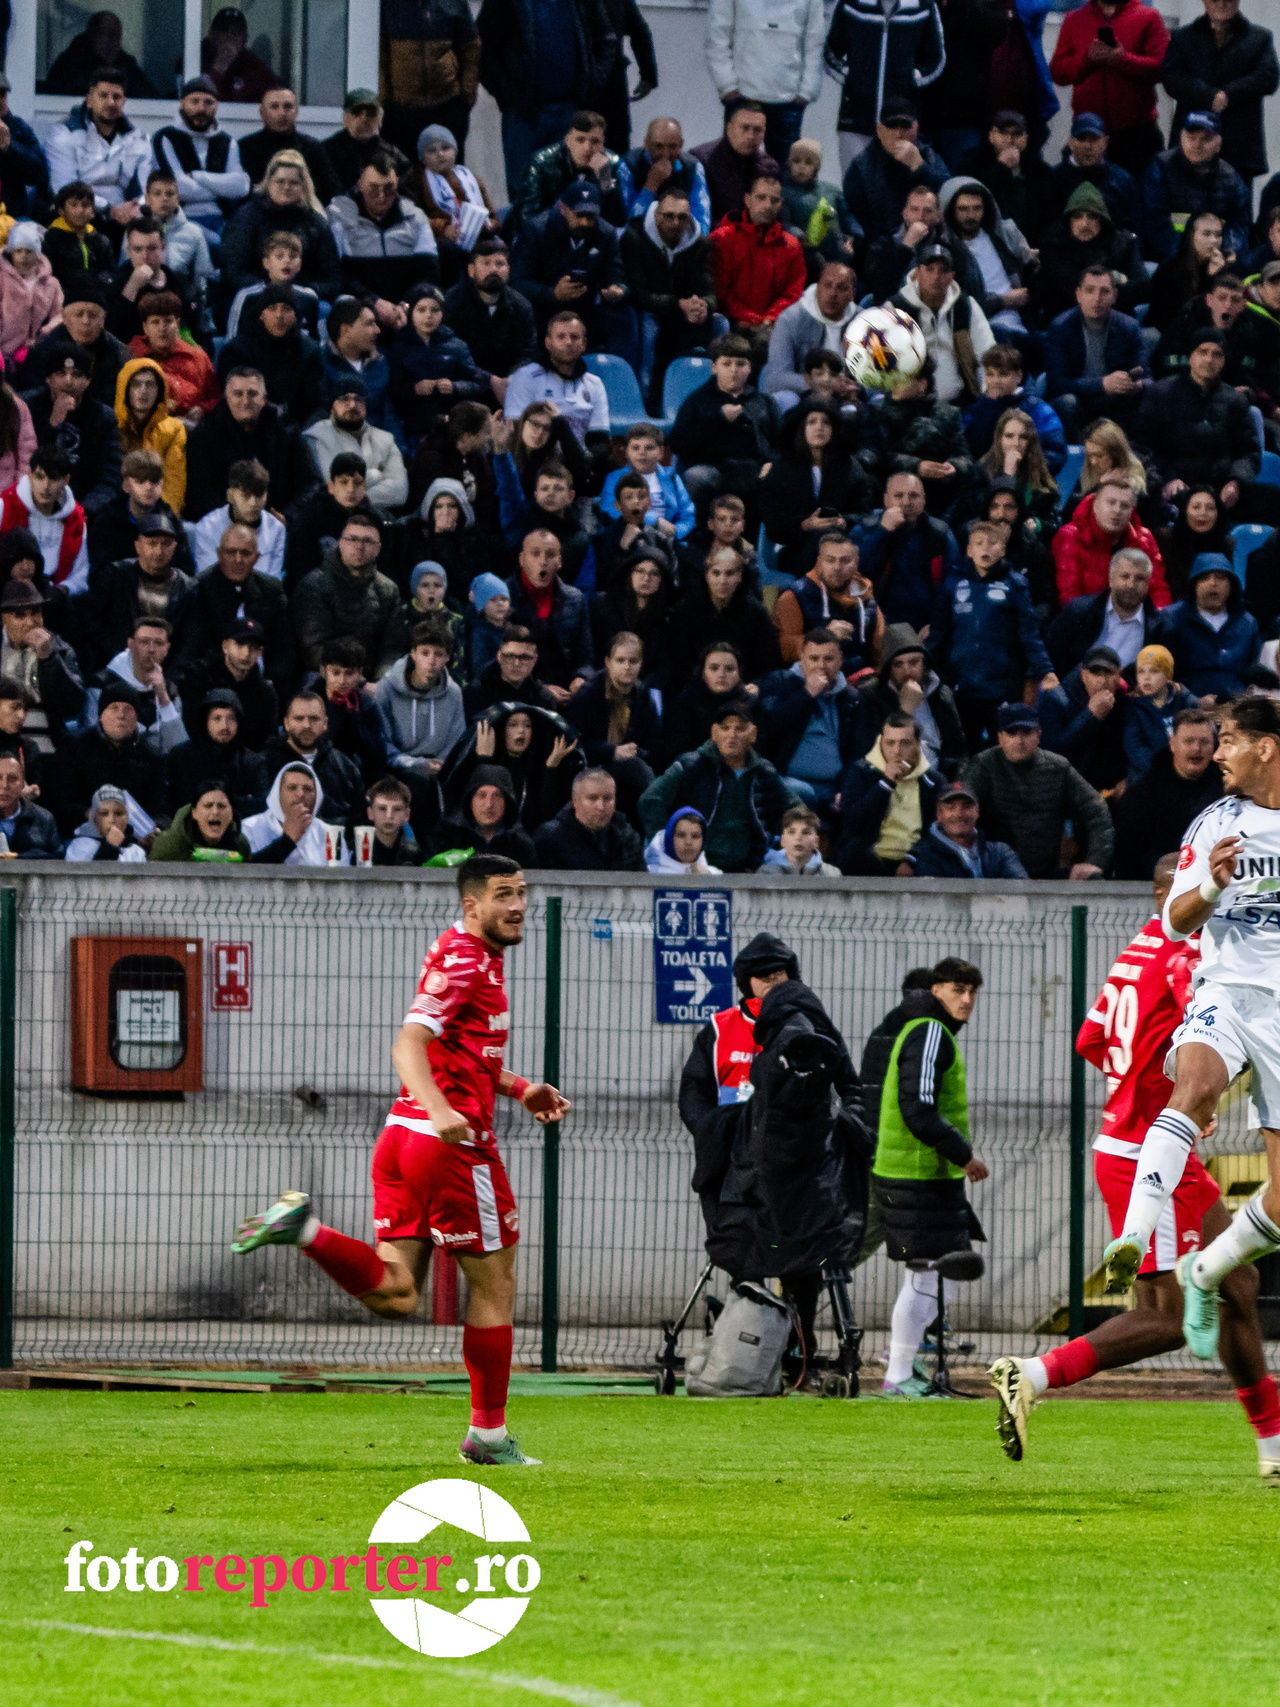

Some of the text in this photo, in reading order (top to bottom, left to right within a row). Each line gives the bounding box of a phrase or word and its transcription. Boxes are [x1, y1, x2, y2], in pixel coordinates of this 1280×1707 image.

[660, 951, 727, 967] TOALETA
[218, 950, 245, 986] H
[668, 1005, 720, 1021] TOILET
[1193, 1028, 1220, 1043] Vestra
[1138, 1179, 1165, 1192] adidas
